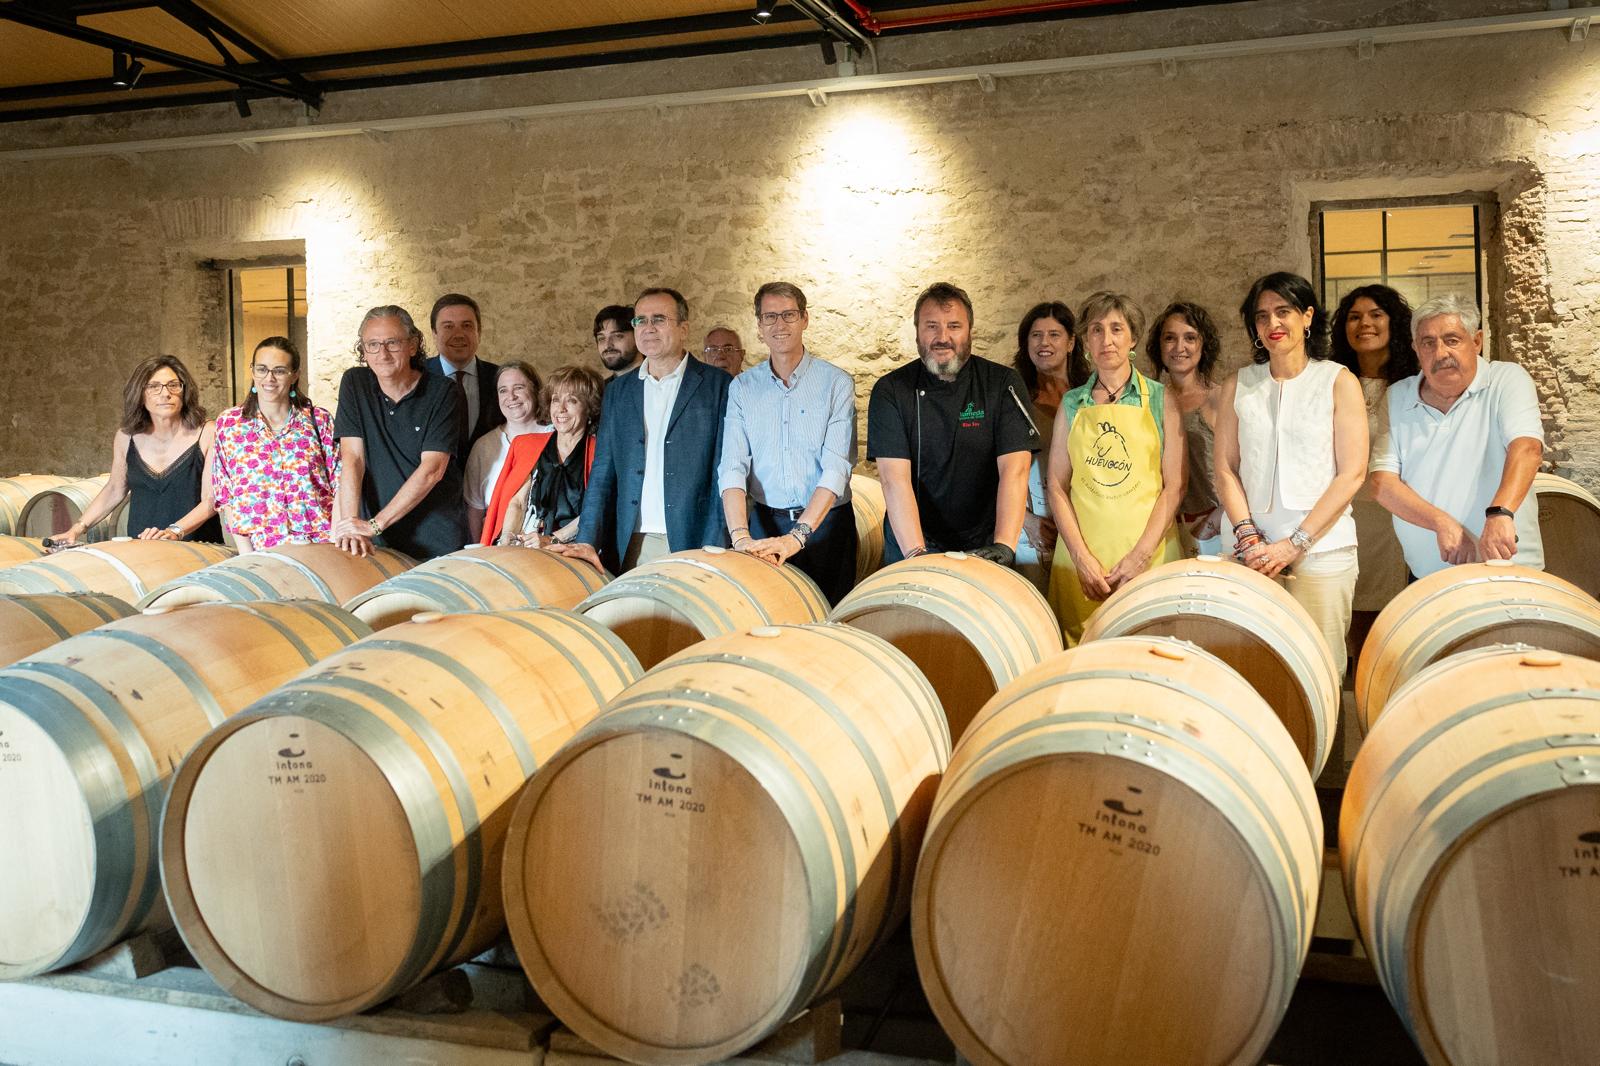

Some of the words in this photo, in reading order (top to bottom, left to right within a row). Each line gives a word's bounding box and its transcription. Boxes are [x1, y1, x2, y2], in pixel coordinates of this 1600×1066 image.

[268, 775, 282, 785] TM
[286, 775, 300, 784] AM
[304, 774, 327, 784] 2020
[636, 793, 652, 804] TM
[657, 797, 674, 808] AM
[680, 800, 706, 813] 2020
[1078, 822, 1097, 837] TM
[1102, 830, 1122, 845] AM
[1128, 837, 1161, 856] 2020
[1558, 866, 1581, 878] TM
